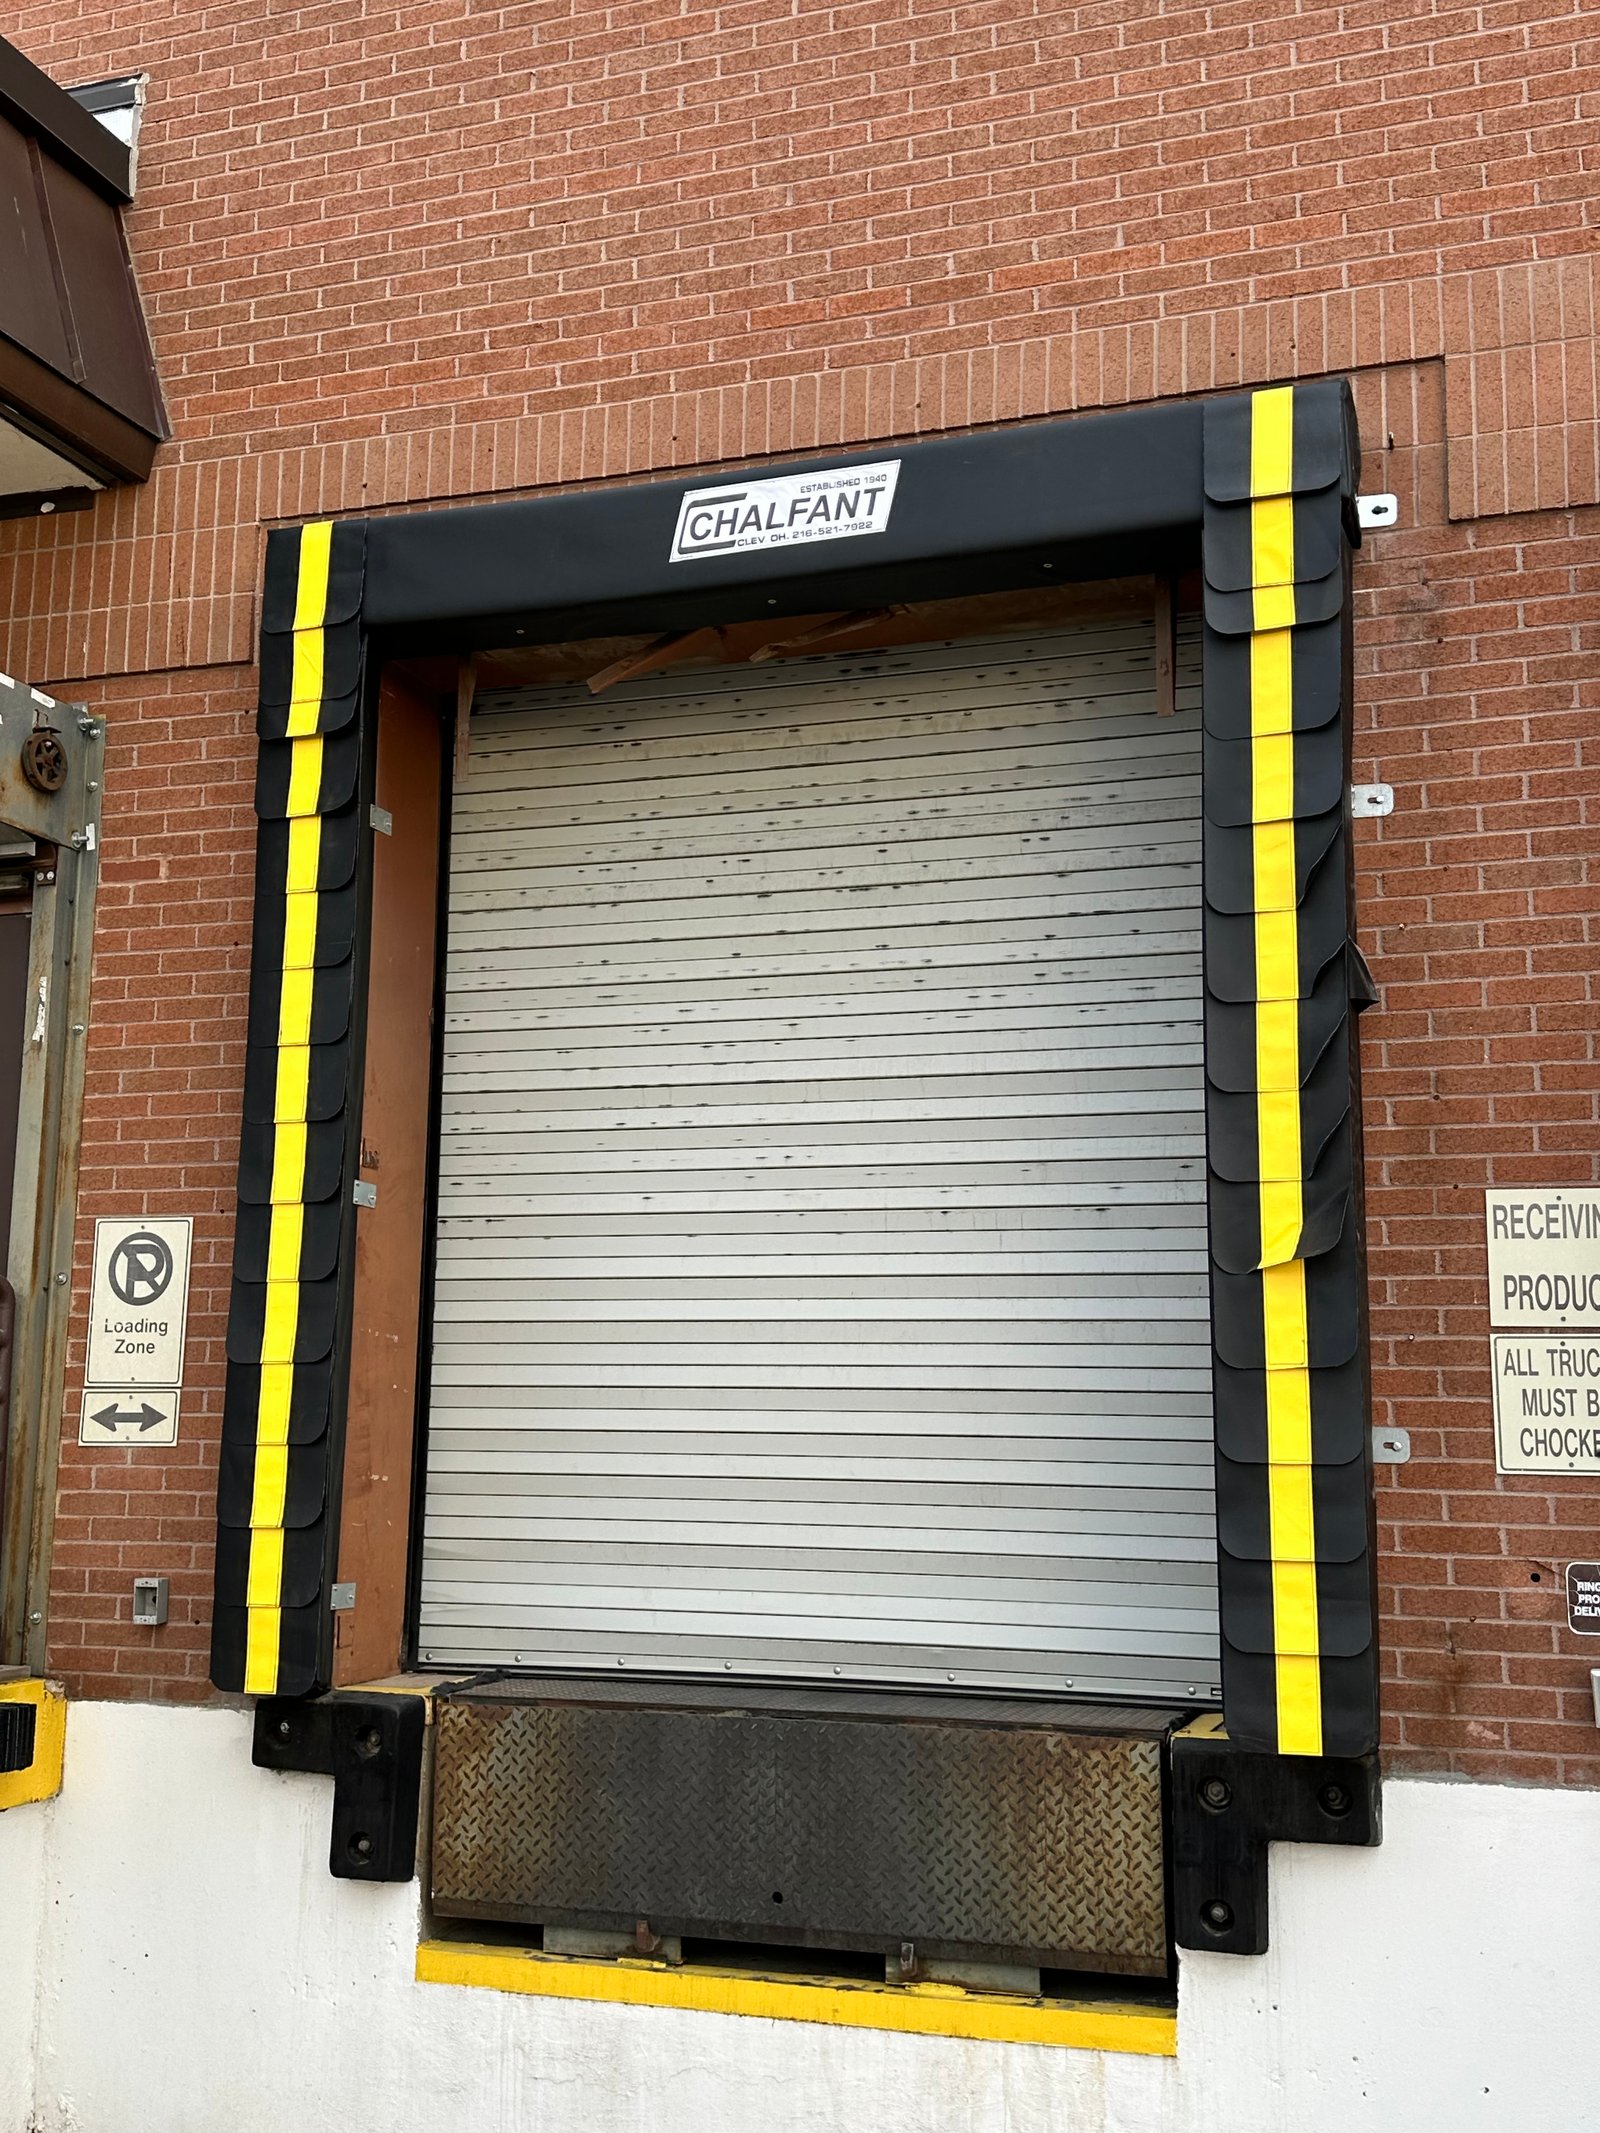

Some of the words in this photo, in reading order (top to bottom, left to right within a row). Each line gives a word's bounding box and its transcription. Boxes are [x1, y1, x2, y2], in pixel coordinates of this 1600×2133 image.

[801, 477, 861, 493] ESTABLISHED
[864, 473, 887, 485] 1940
[690, 486, 886, 541] CHALFANT
[737, 535, 766, 547] CLEV
[770, 533, 790, 543] OH.
[792, 520, 873, 540] 216-521-7922
[1503, 1273, 1600, 1312] PRODUC
[104, 1318, 168, 1337] Loading
[114, 1338, 156, 1354] Zone
[1503, 1348, 1540, 1377] ALL
[1546, 1347, 1600, 1378] TRUC
[1521, 1388, 1578, 1418] MUST
[1586, 1388, 1600, 1417] B
[1578, 1593, 1600, 1605] PRO
